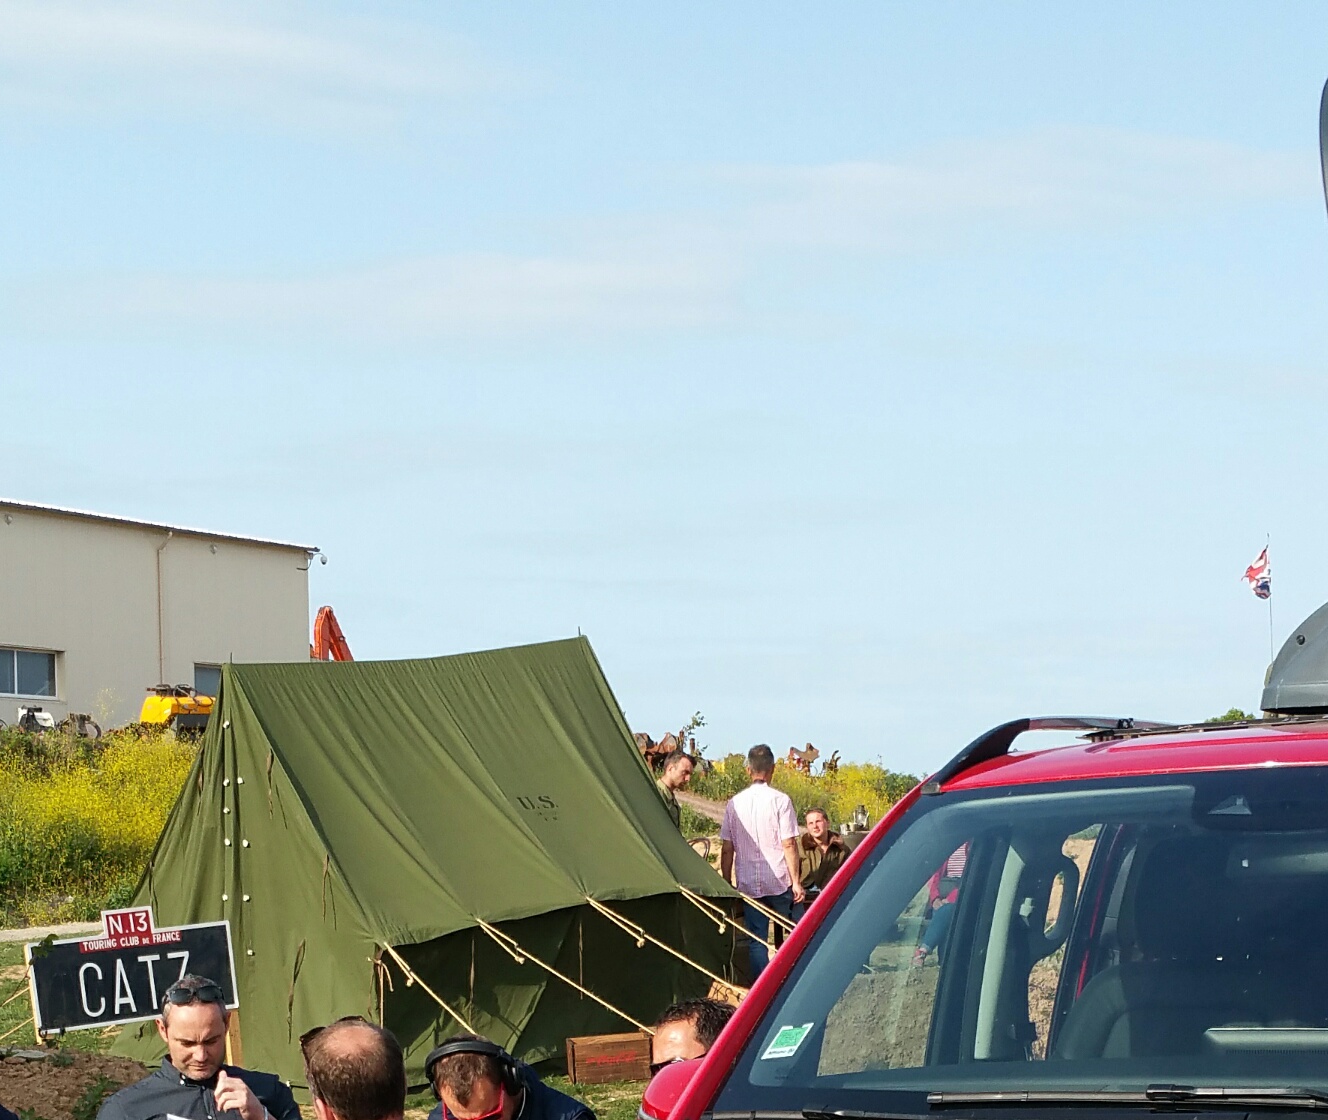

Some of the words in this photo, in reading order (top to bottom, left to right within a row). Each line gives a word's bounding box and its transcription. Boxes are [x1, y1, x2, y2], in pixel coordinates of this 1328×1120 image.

[108, 912, 148, 935] N.13
[83, 938, 117, 952] TOURING
[120, 935, 140, 947] CLUB
[153, 931, 181, 943] FRANCE
